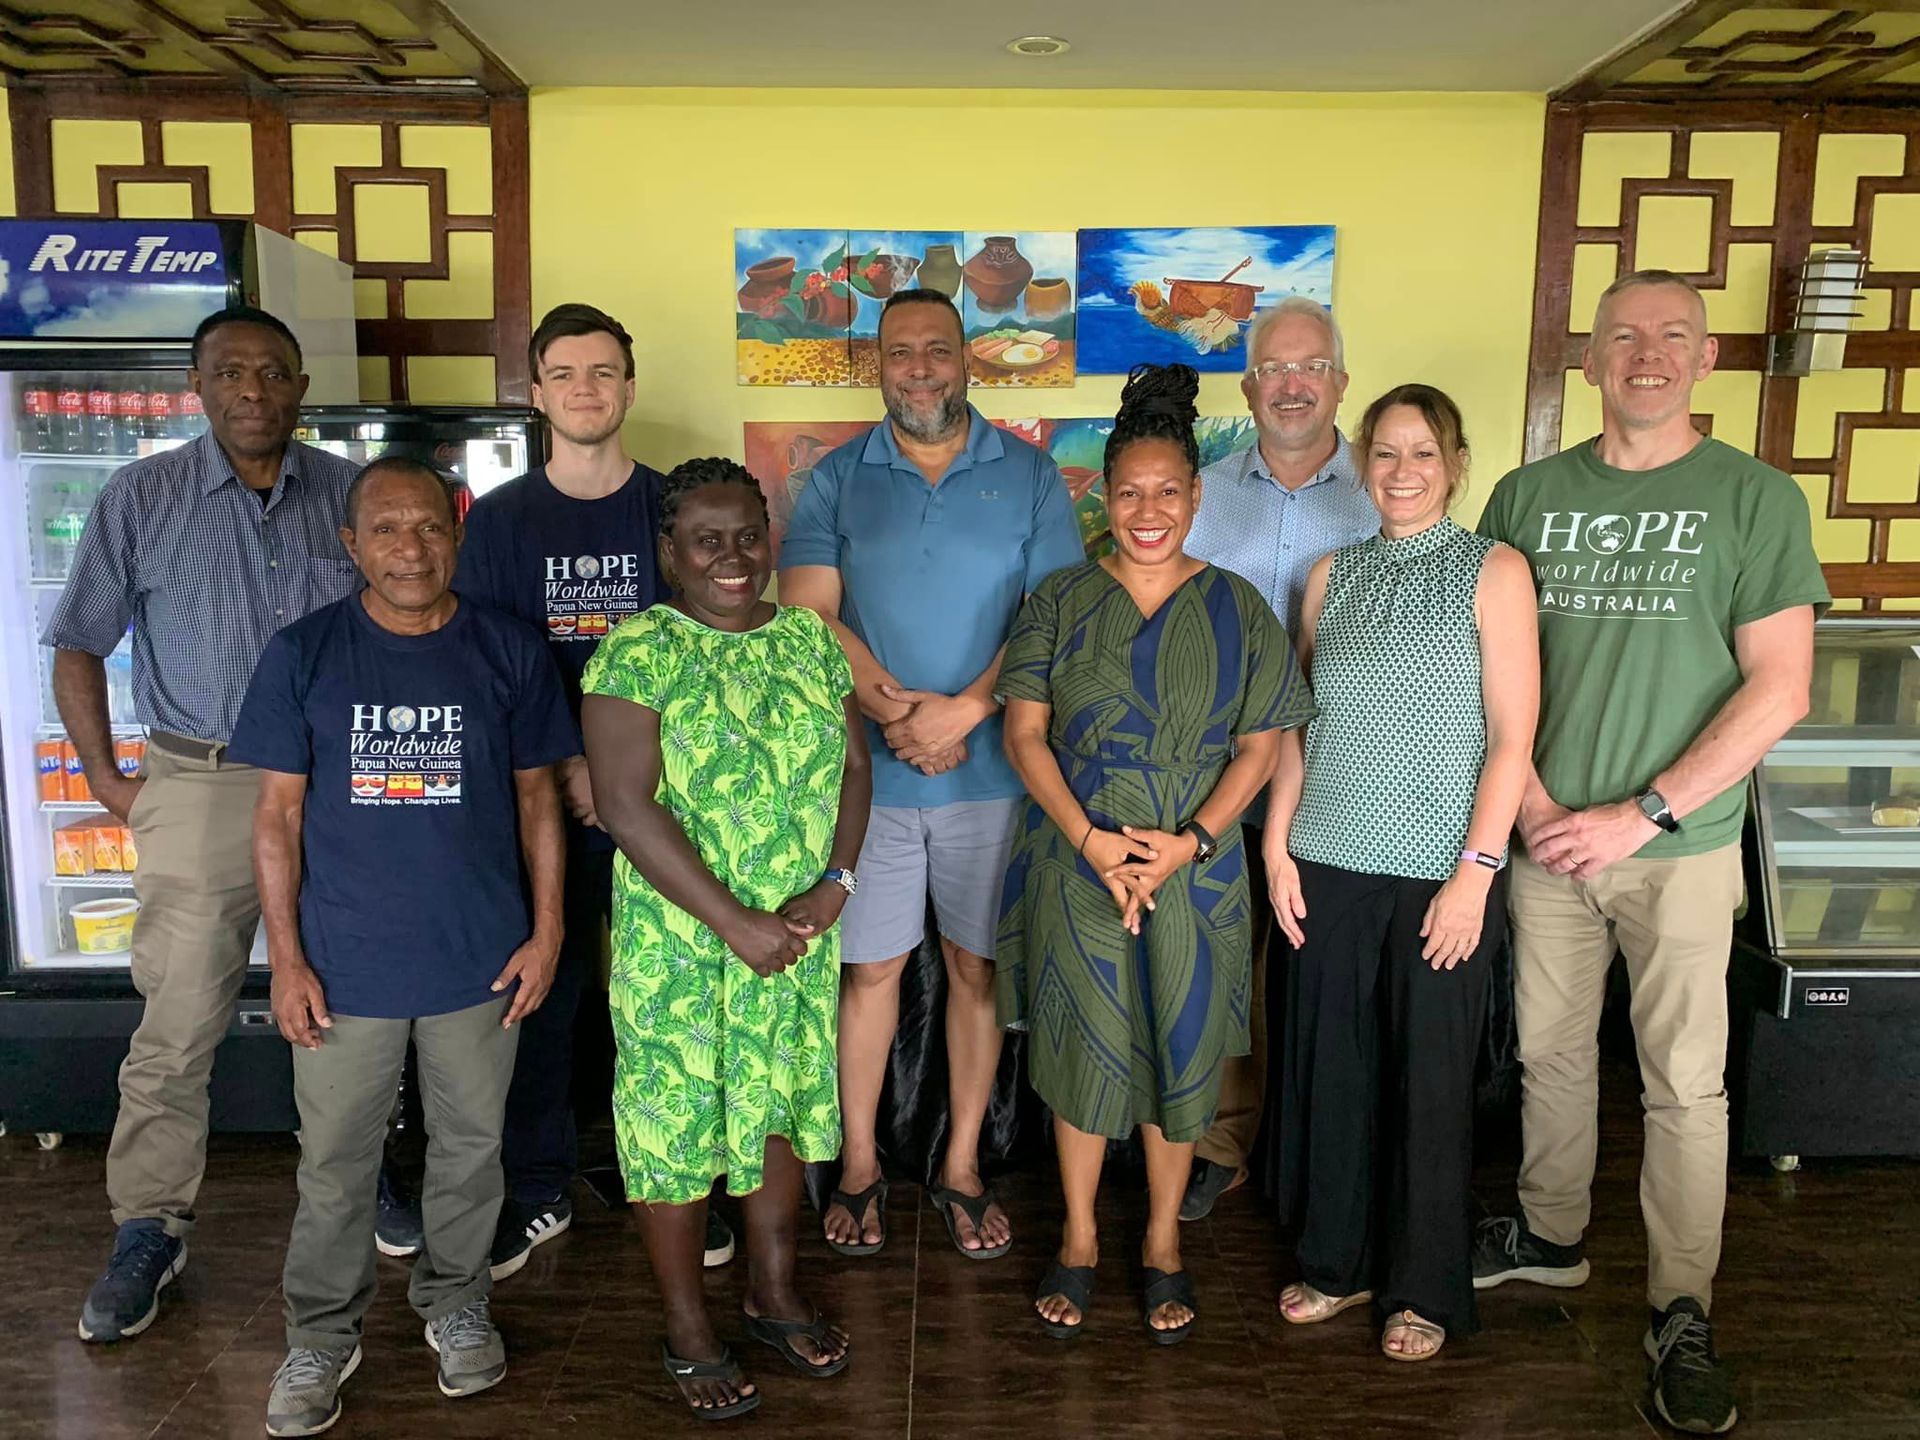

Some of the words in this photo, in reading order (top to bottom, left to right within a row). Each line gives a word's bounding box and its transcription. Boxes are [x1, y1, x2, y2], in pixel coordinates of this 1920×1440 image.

[1535, 511, 1708, 555] HOPE
[544, 554, 639, 580] HOPE
[1536, 559, 1696, 583] worldwide
[545, 579, 638, 599] Worldwide
[546, 602, 576, 615] Papua
[578, 601, 601, 611] New
[603, 599, 638, 610] Guinea
[1543, 591, 1676, 612] AUSTRALIA
[350, 704, 463, 733] HOPE
[350, 732, 462, 755] Worldwide
[351, 757, 386, 772] Papua
[388, 758, 417, 769] New
[419, 758, 461, 769] Guinea
[350, 797, 380, 805] Bringing
